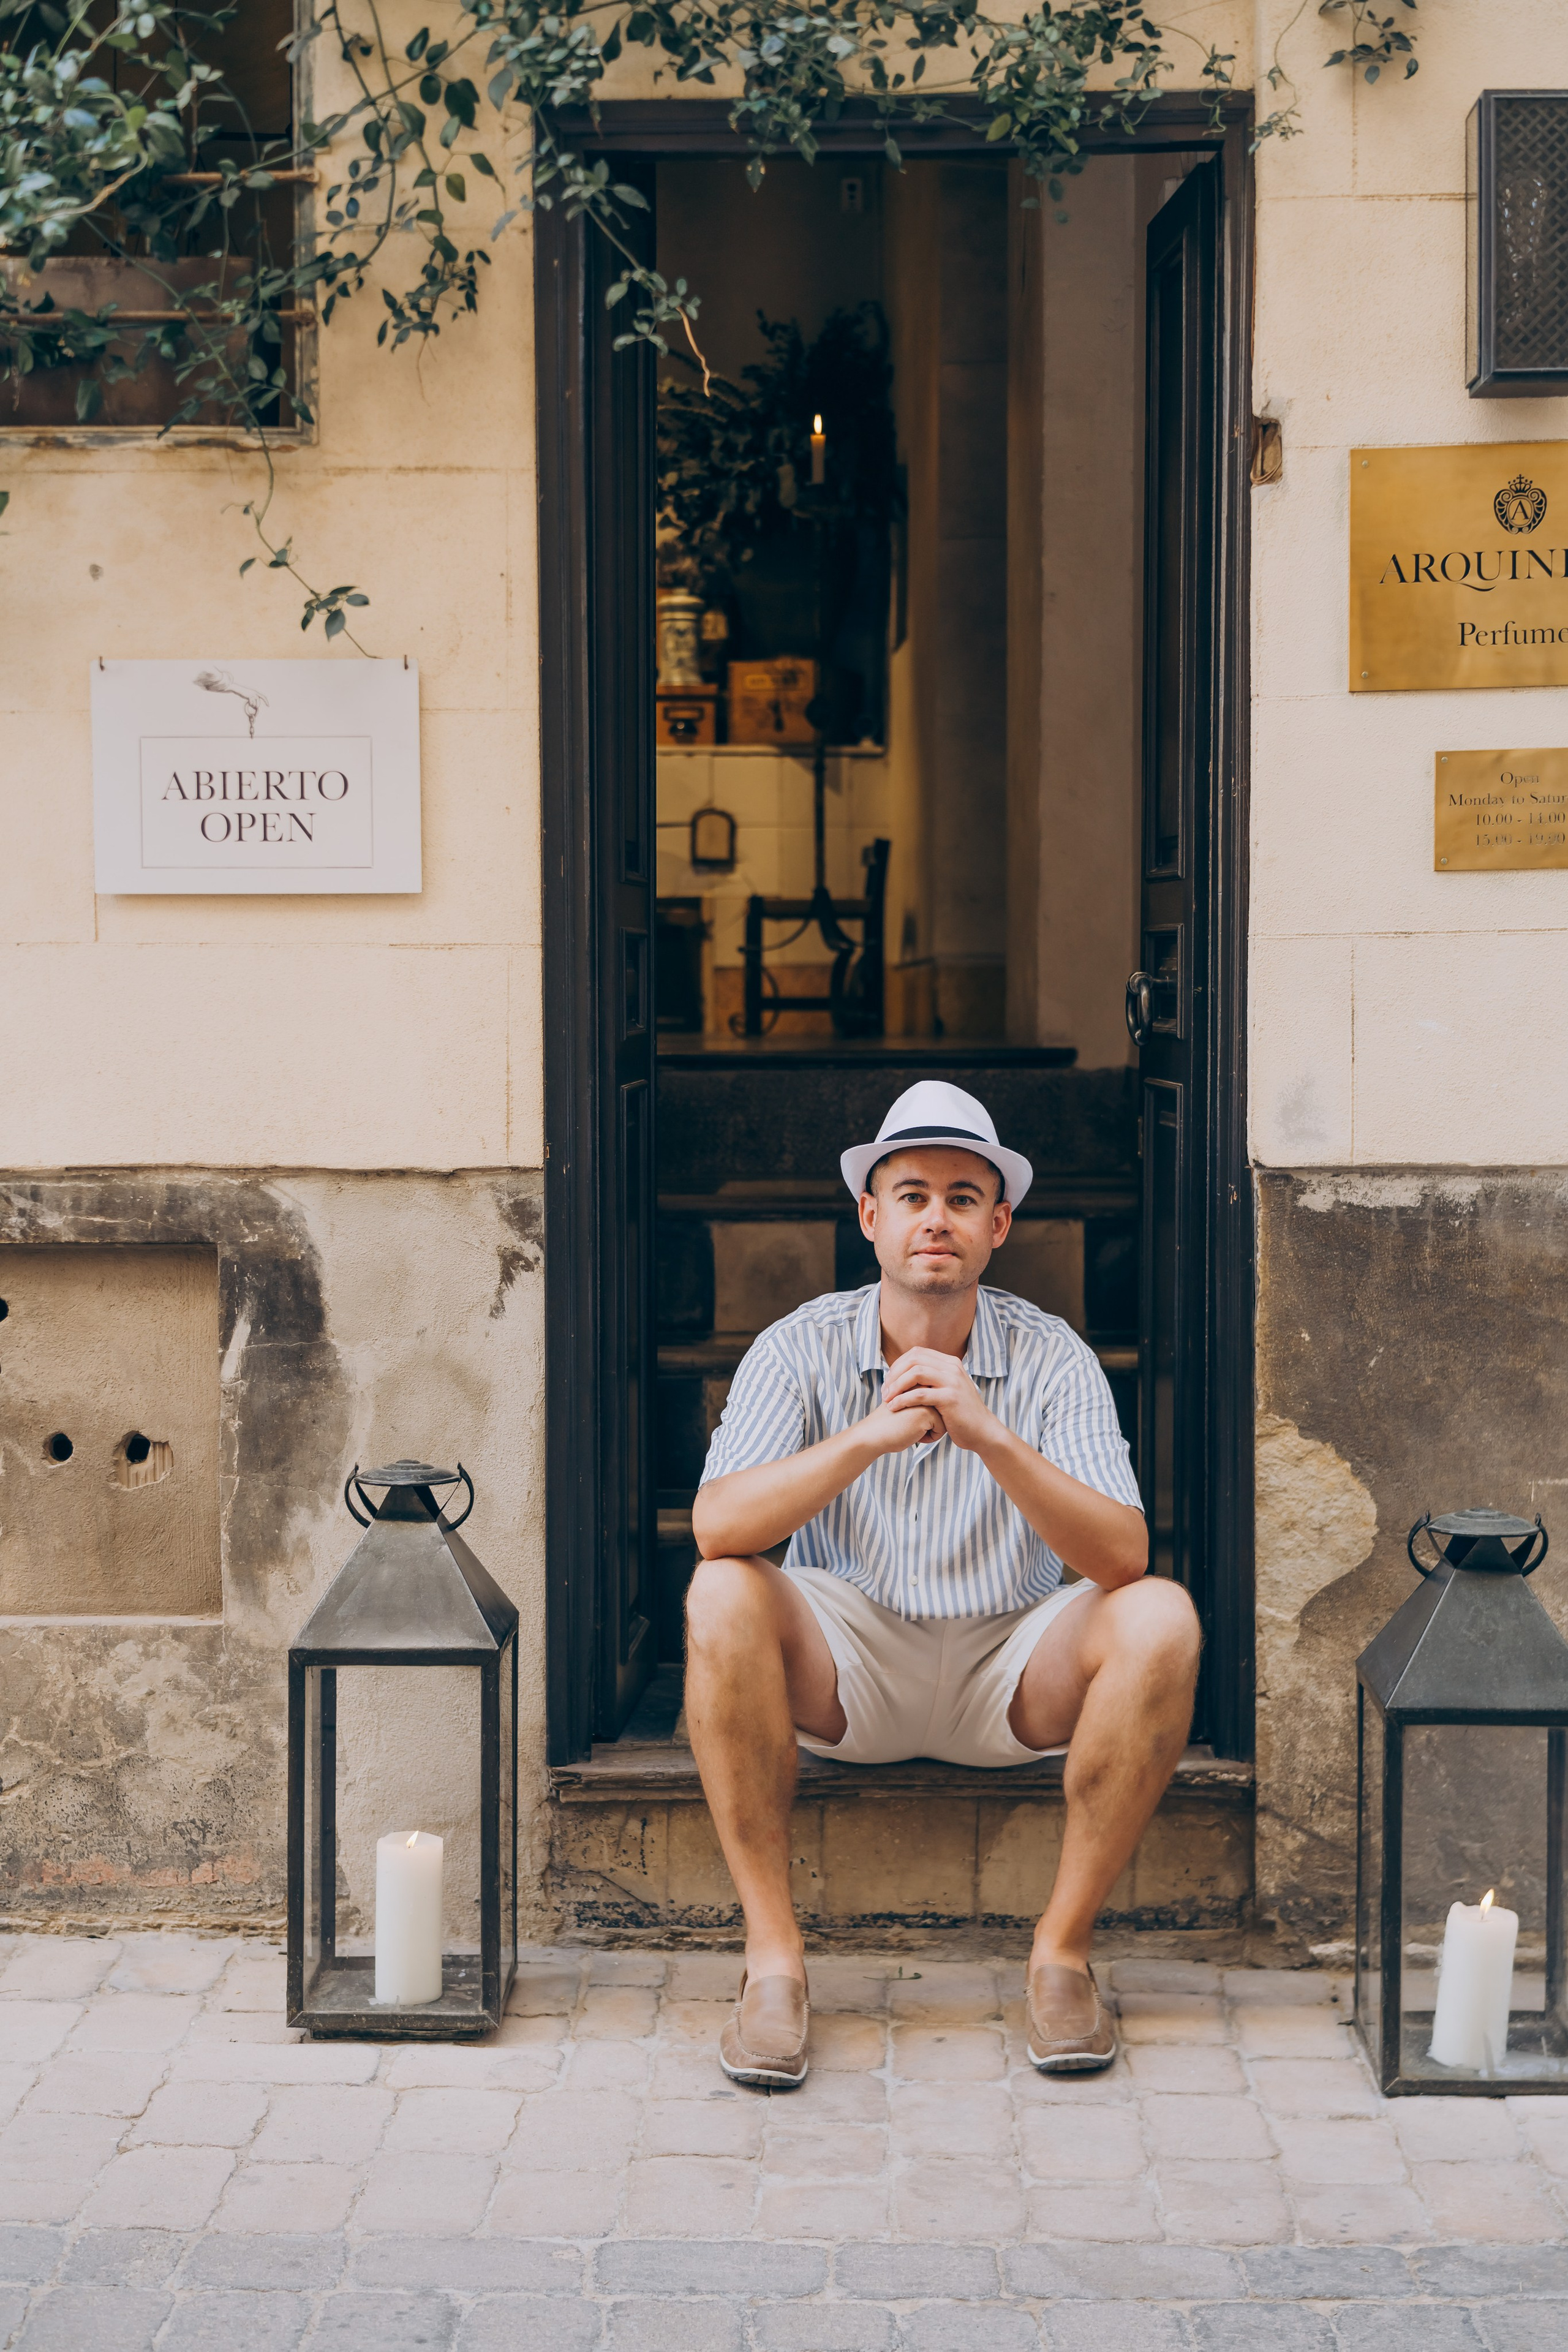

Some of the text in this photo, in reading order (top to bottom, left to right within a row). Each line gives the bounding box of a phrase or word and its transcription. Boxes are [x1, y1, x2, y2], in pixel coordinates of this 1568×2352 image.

[1511, 500, 1529, 521] A
[161, 771, 349, 801] ABIERTO
[1501, 772, 1539, 788] Open
[1449, 793, 1504, 809] Monday
[1512, 795, 1525, 804] to
[1476, 813, 1512, 826] 10.00
[1529, 812, 1566, 824] 14.00
[200, 812, 317, 843] OPEN
[1476, 834, 1512, 846] 15.00
